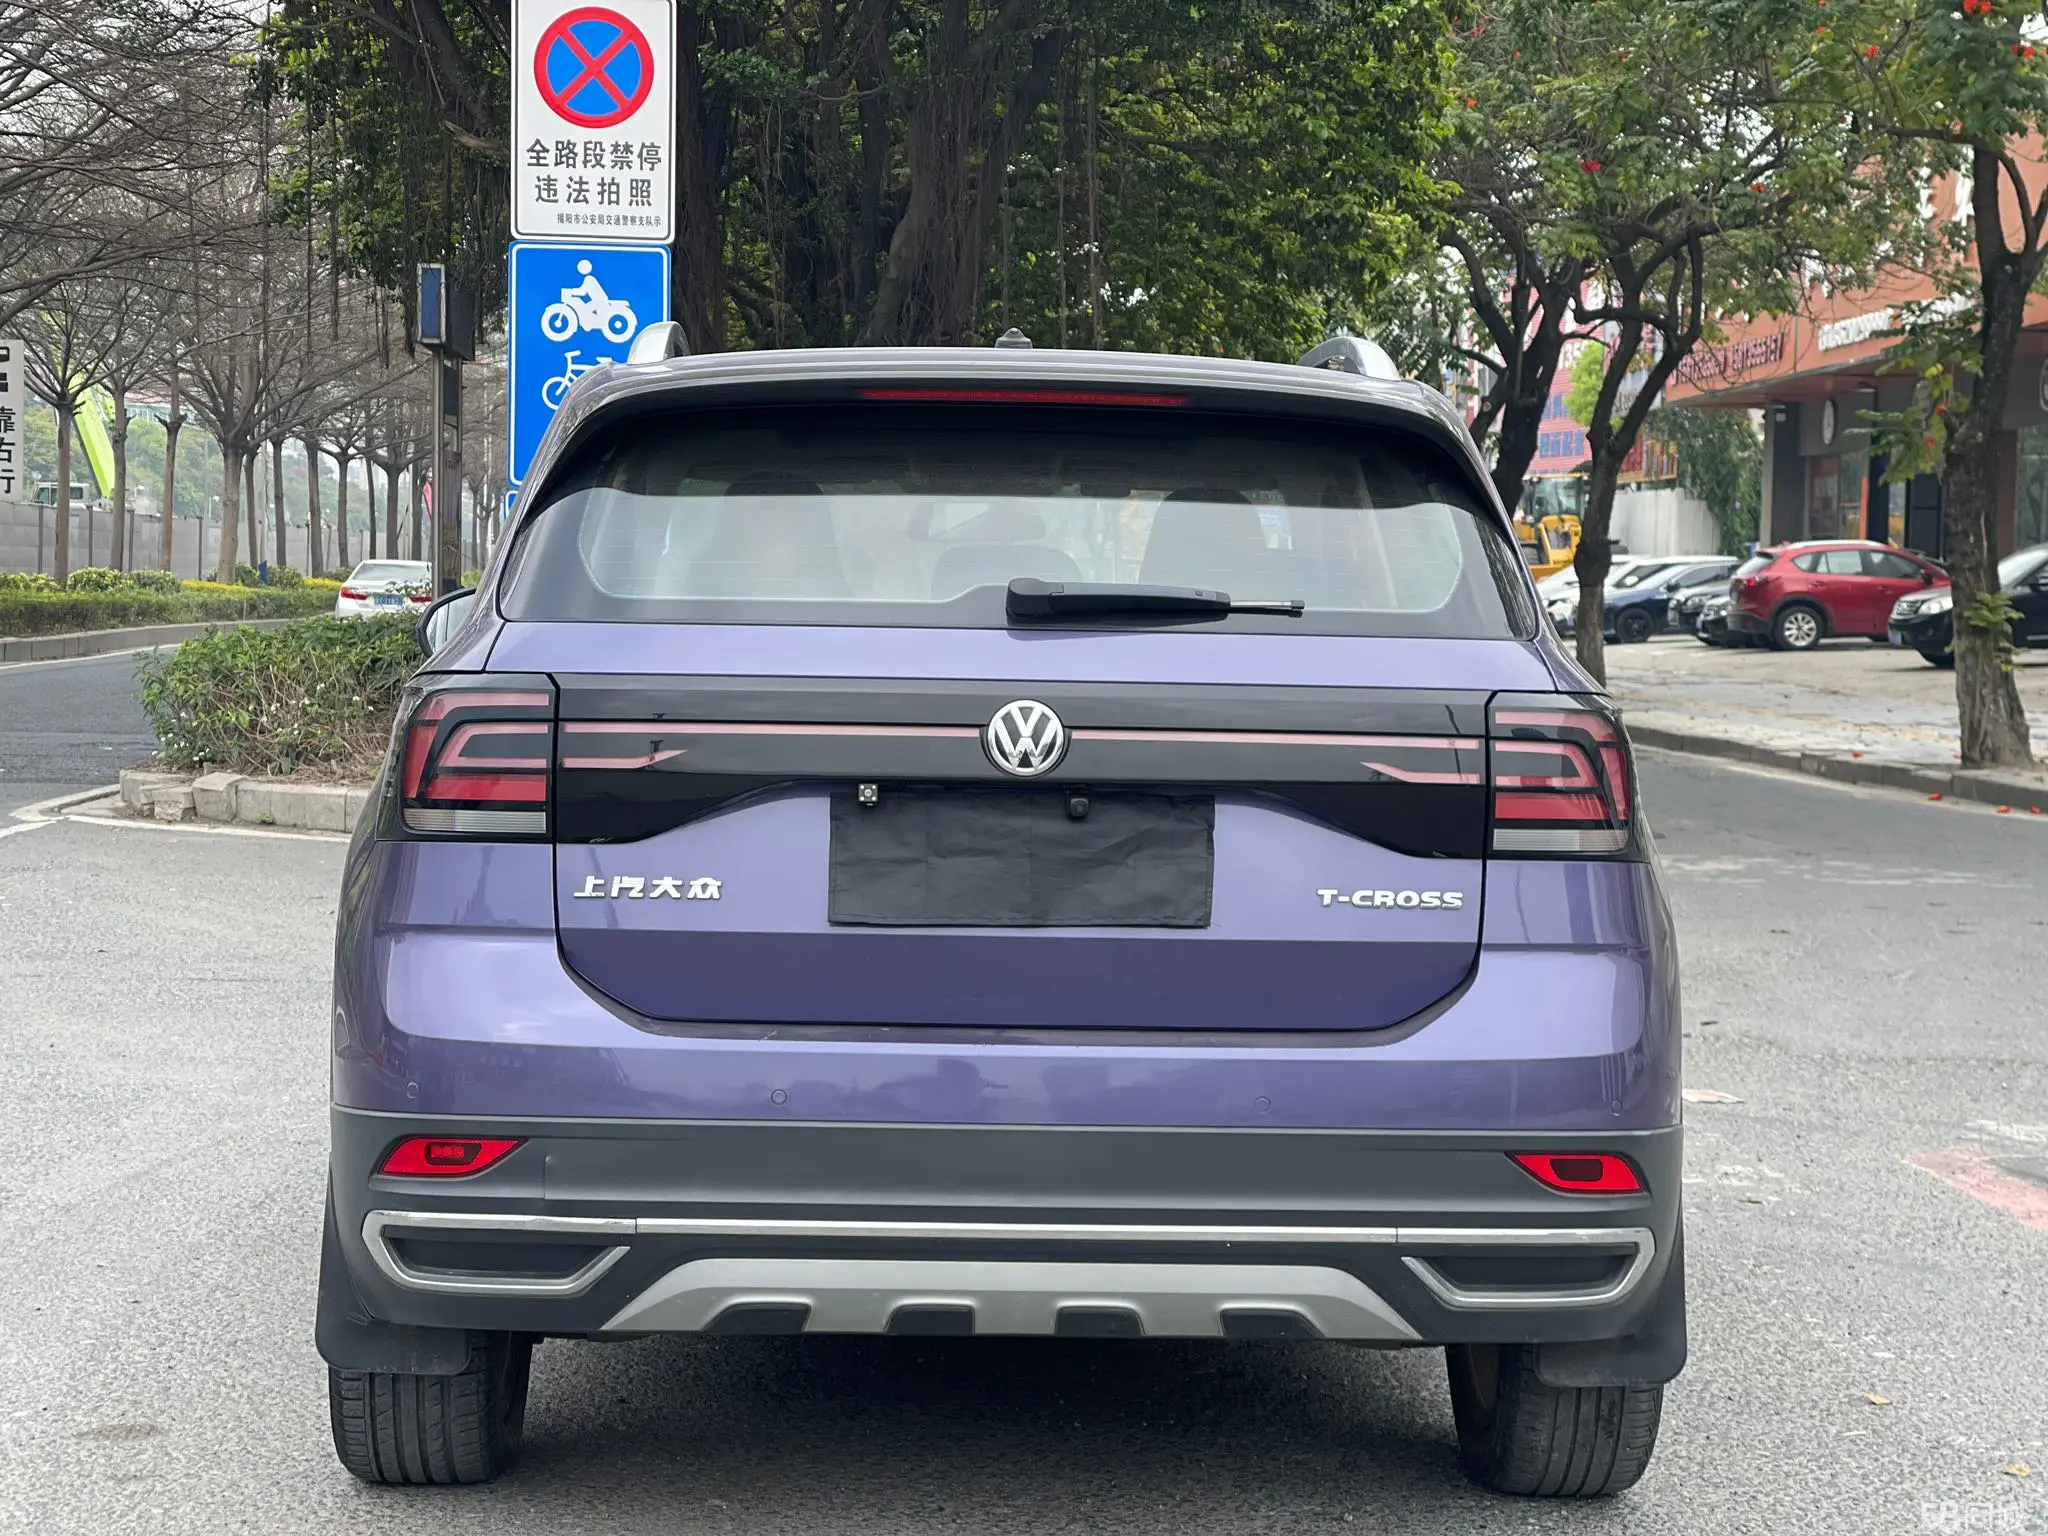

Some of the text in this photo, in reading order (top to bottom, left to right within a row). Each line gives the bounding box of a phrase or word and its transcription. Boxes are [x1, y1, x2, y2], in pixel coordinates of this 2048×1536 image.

[526, 138, 662, 171] 全路段禁停
[534, 174, 653, 207] 违法拍照
[573, 875, 722, 899] 上汽大众
[1316, 888, 1464, 909] T-CROSS
